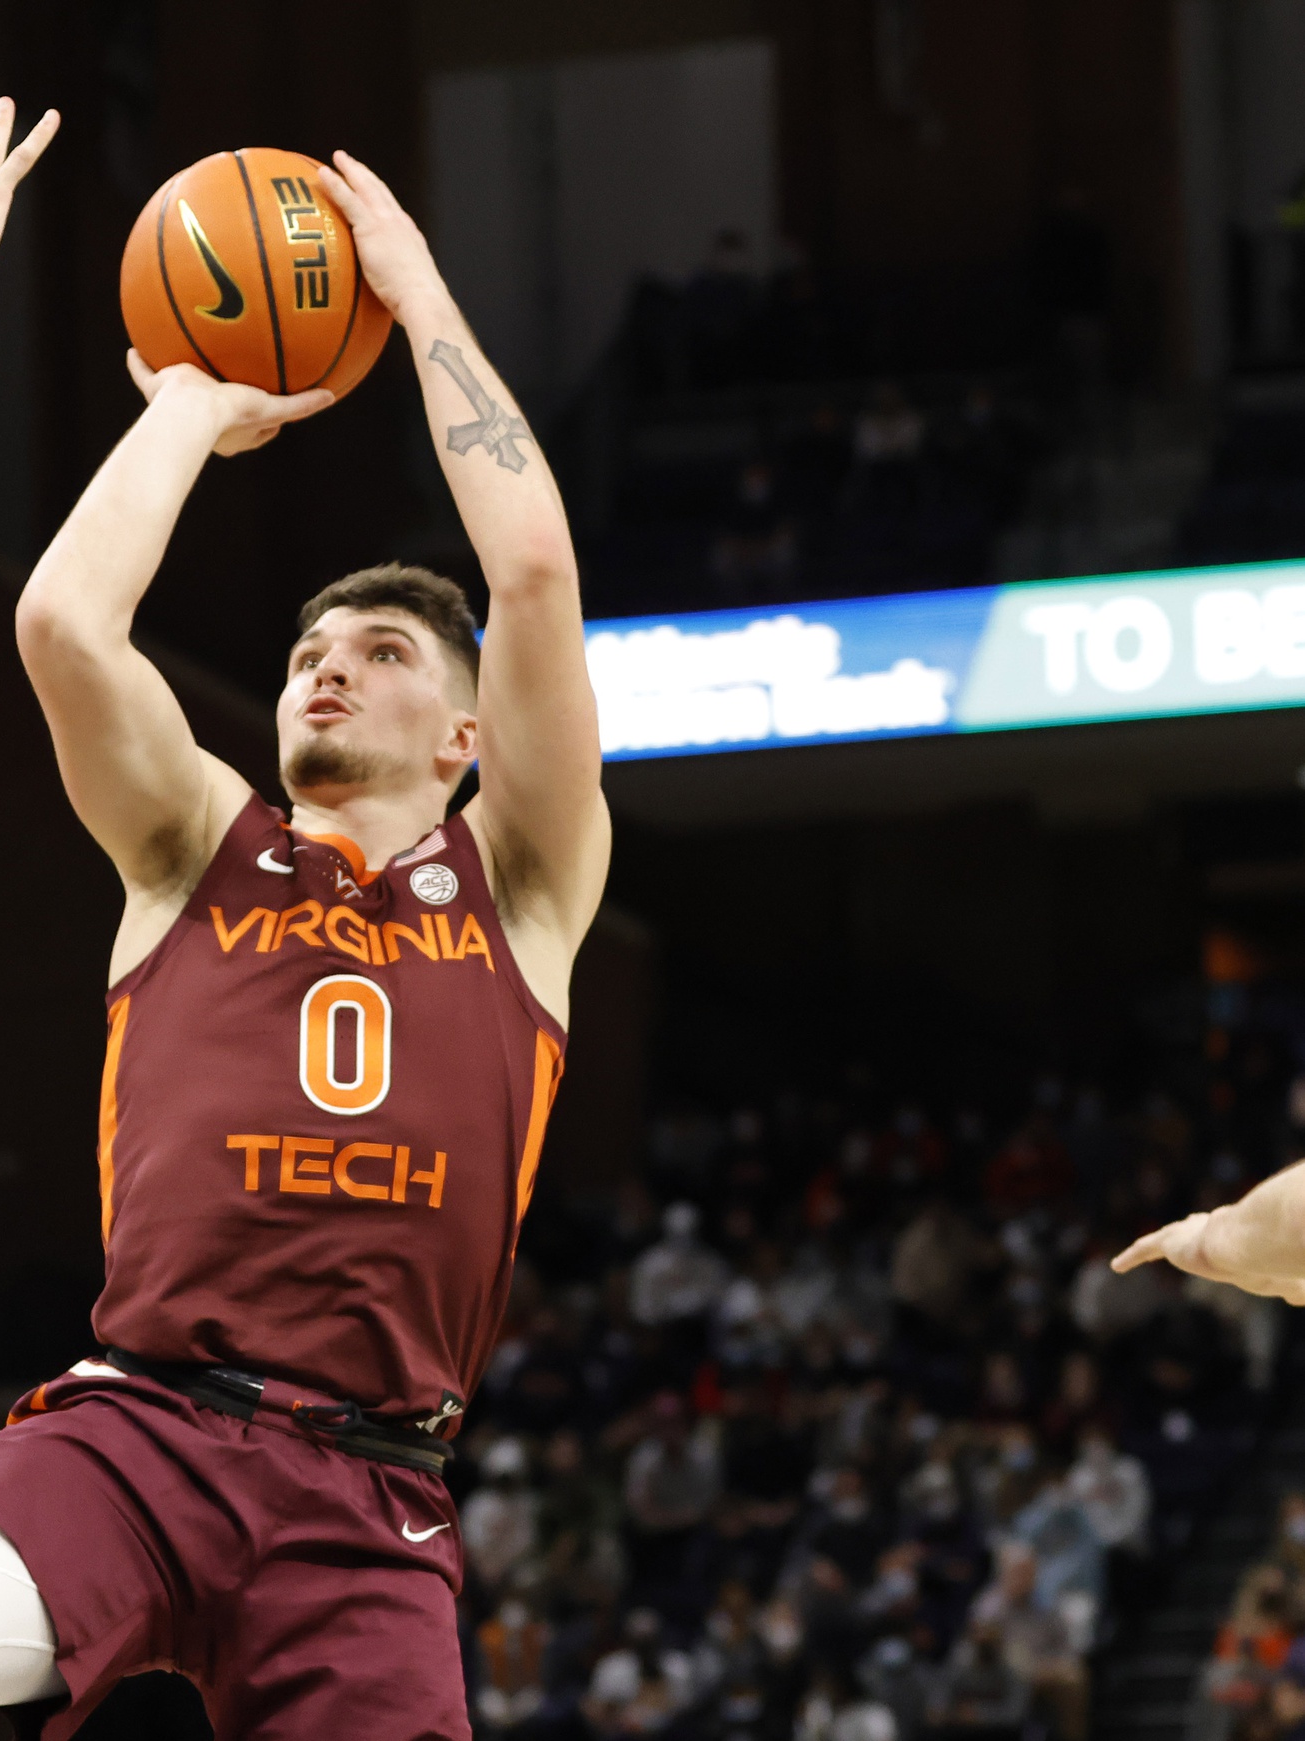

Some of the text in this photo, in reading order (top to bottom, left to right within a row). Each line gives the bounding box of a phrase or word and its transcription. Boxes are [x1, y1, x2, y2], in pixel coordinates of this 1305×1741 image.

[271, 177, 330, 309] ELITE
[1025, 596, 1173, 695] TO
[418, 873, 451, 886] ACC
[209, 900, 495, 973] VIRGINIA
[299, 974, 392, 1115] 0
[226, 1134, 447, 1208] TECH
